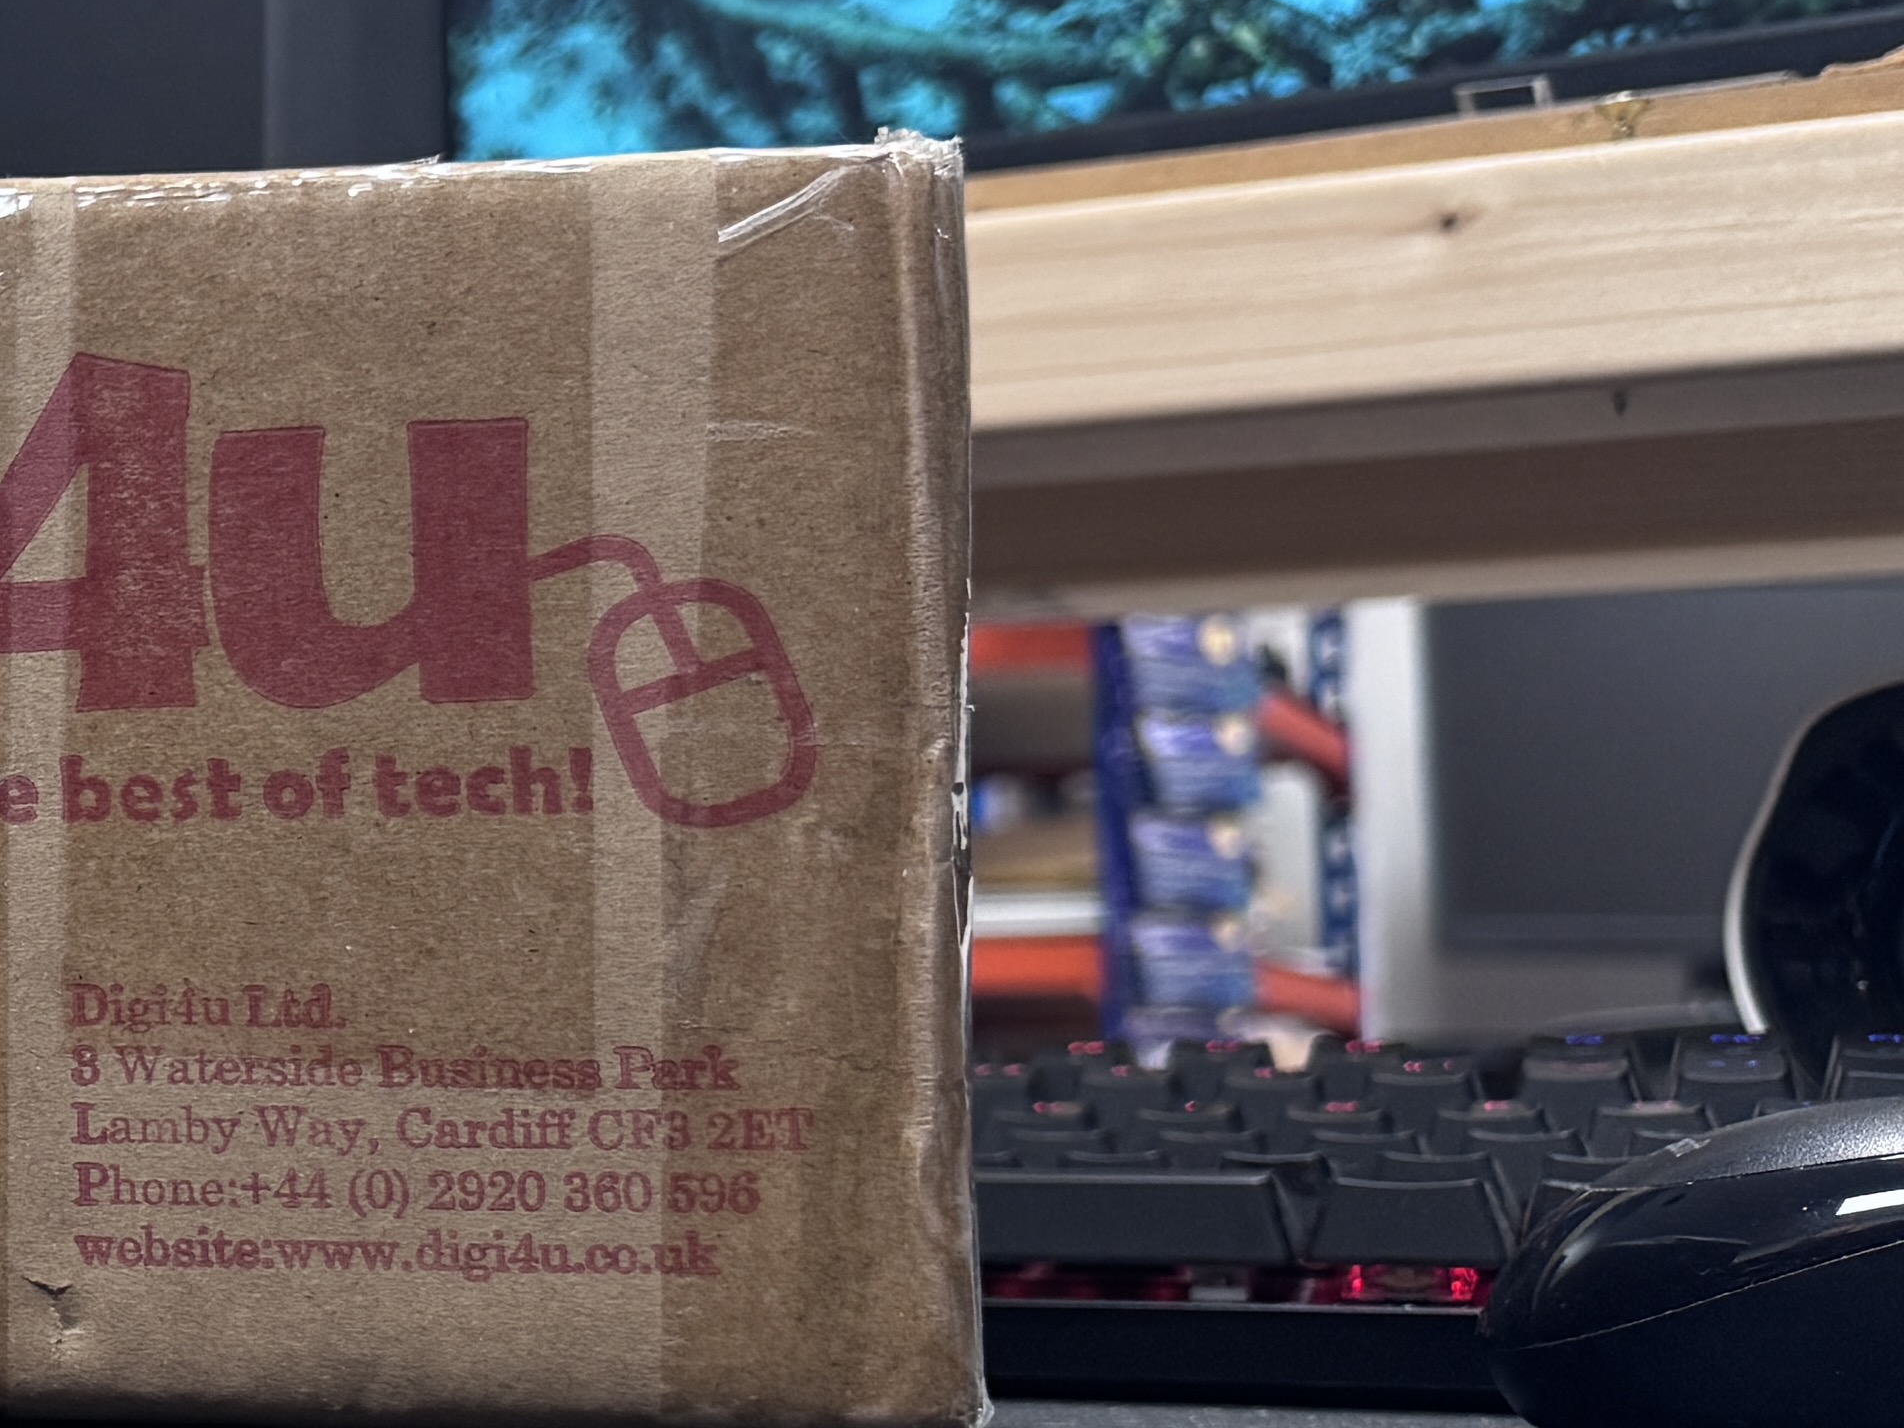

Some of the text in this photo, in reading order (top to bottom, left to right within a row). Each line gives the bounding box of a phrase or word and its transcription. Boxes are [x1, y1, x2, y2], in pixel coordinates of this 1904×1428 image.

[60, 755, 243, 823] best
[263, 747, 350, 819] of
[376, 746, 594, 816] tech!
[66, 983, 347, 1033] Digi4u Ltd.
[114, 1045, 363, 1087] Waterside
[375, 1044, 603, 1089] Business
[613, 1045, 741, 1090] Park
[71, 1102, 815, 1156] Lamby Way, Cardiff CF3 2ET
[72, 1162, 762, 1219] Phone:+44 (0) 2920 360 596
[73, 1225, 721, 1283] website:www.digi4u.co.uk
